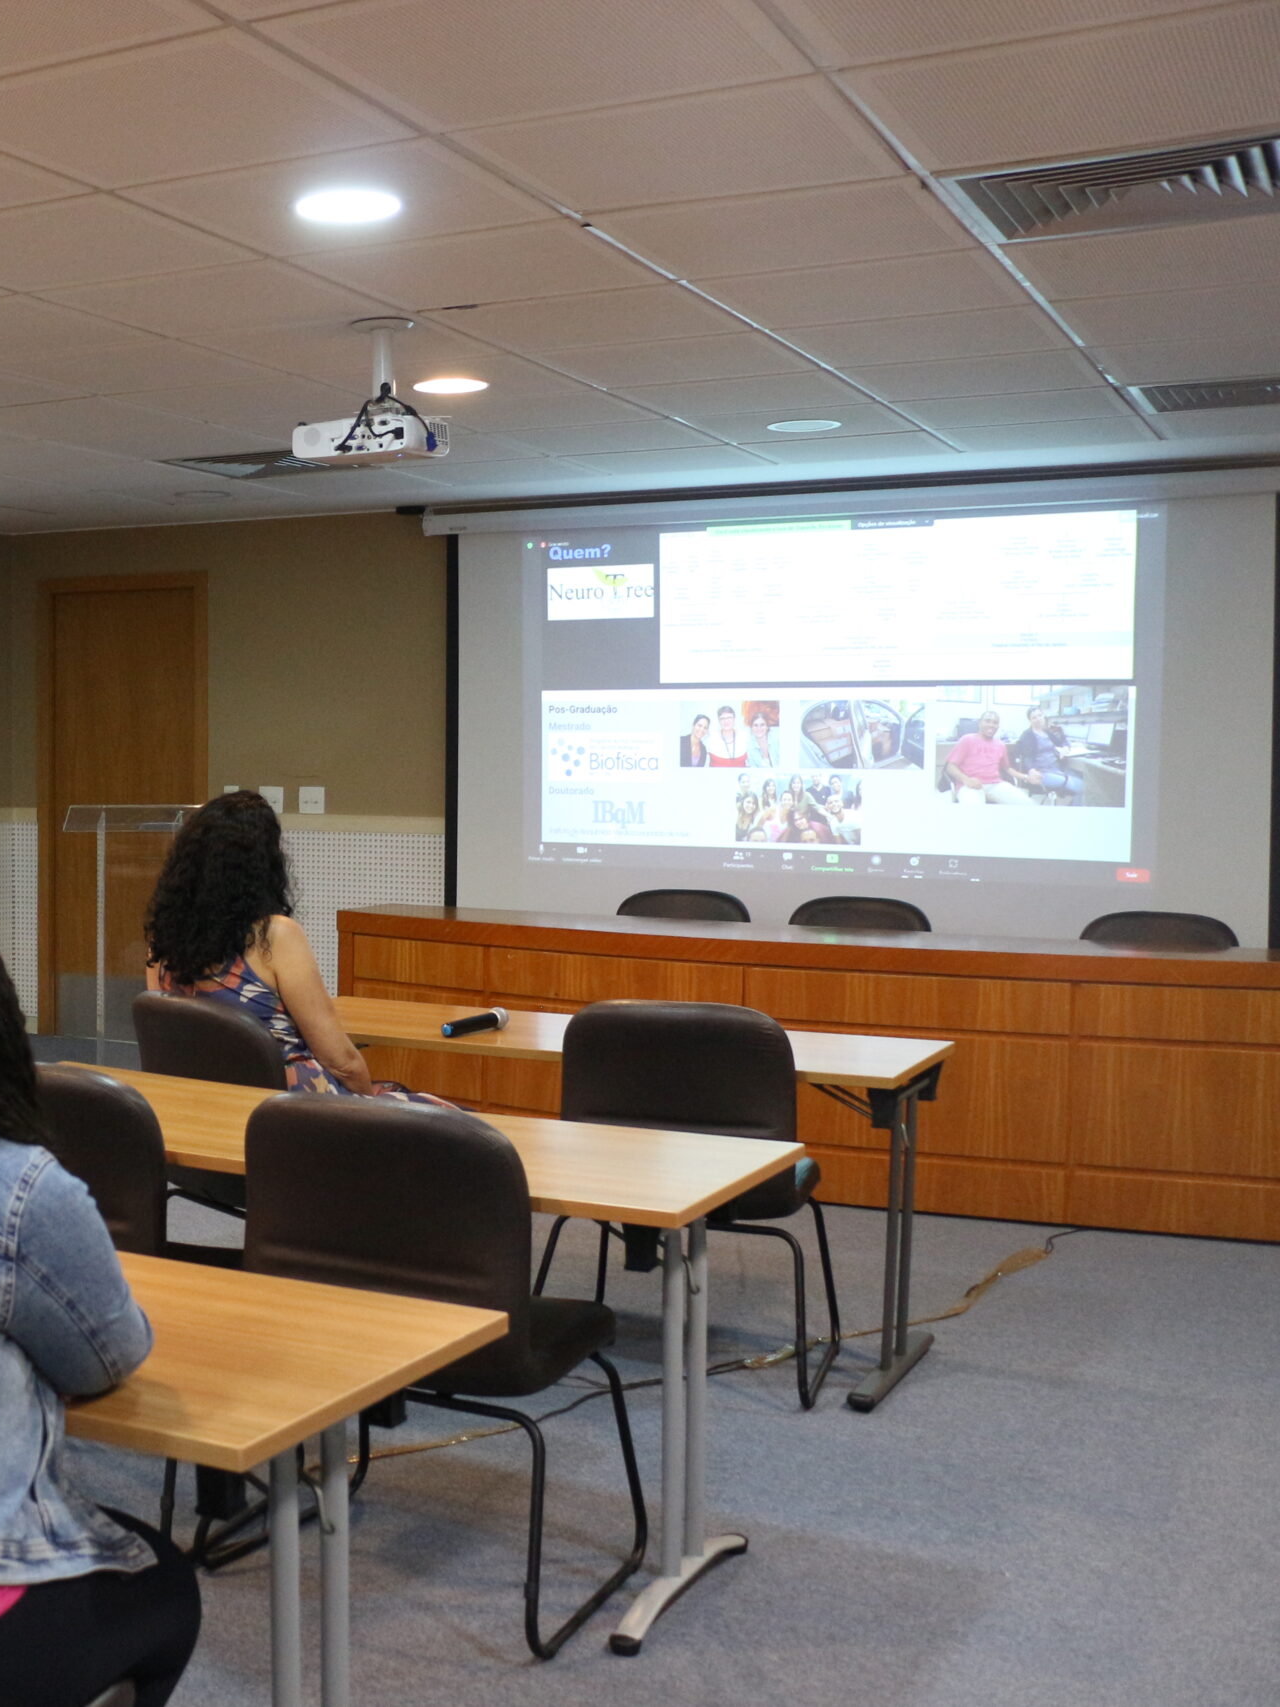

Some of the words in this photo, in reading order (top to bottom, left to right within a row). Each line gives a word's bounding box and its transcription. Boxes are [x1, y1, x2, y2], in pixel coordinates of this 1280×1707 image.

[549, 544, 611, 560] Quem?
[549, 584, 604, 601] Neuro
[548, 704, 617, 716] Pos-Graduação
[548, 722, 591, 731] Mestrado
[589, 752, 659, 771] Biofísica
[548, 786, 594, 795] Doutorado
[592, 800, 646, 829] IBqM
